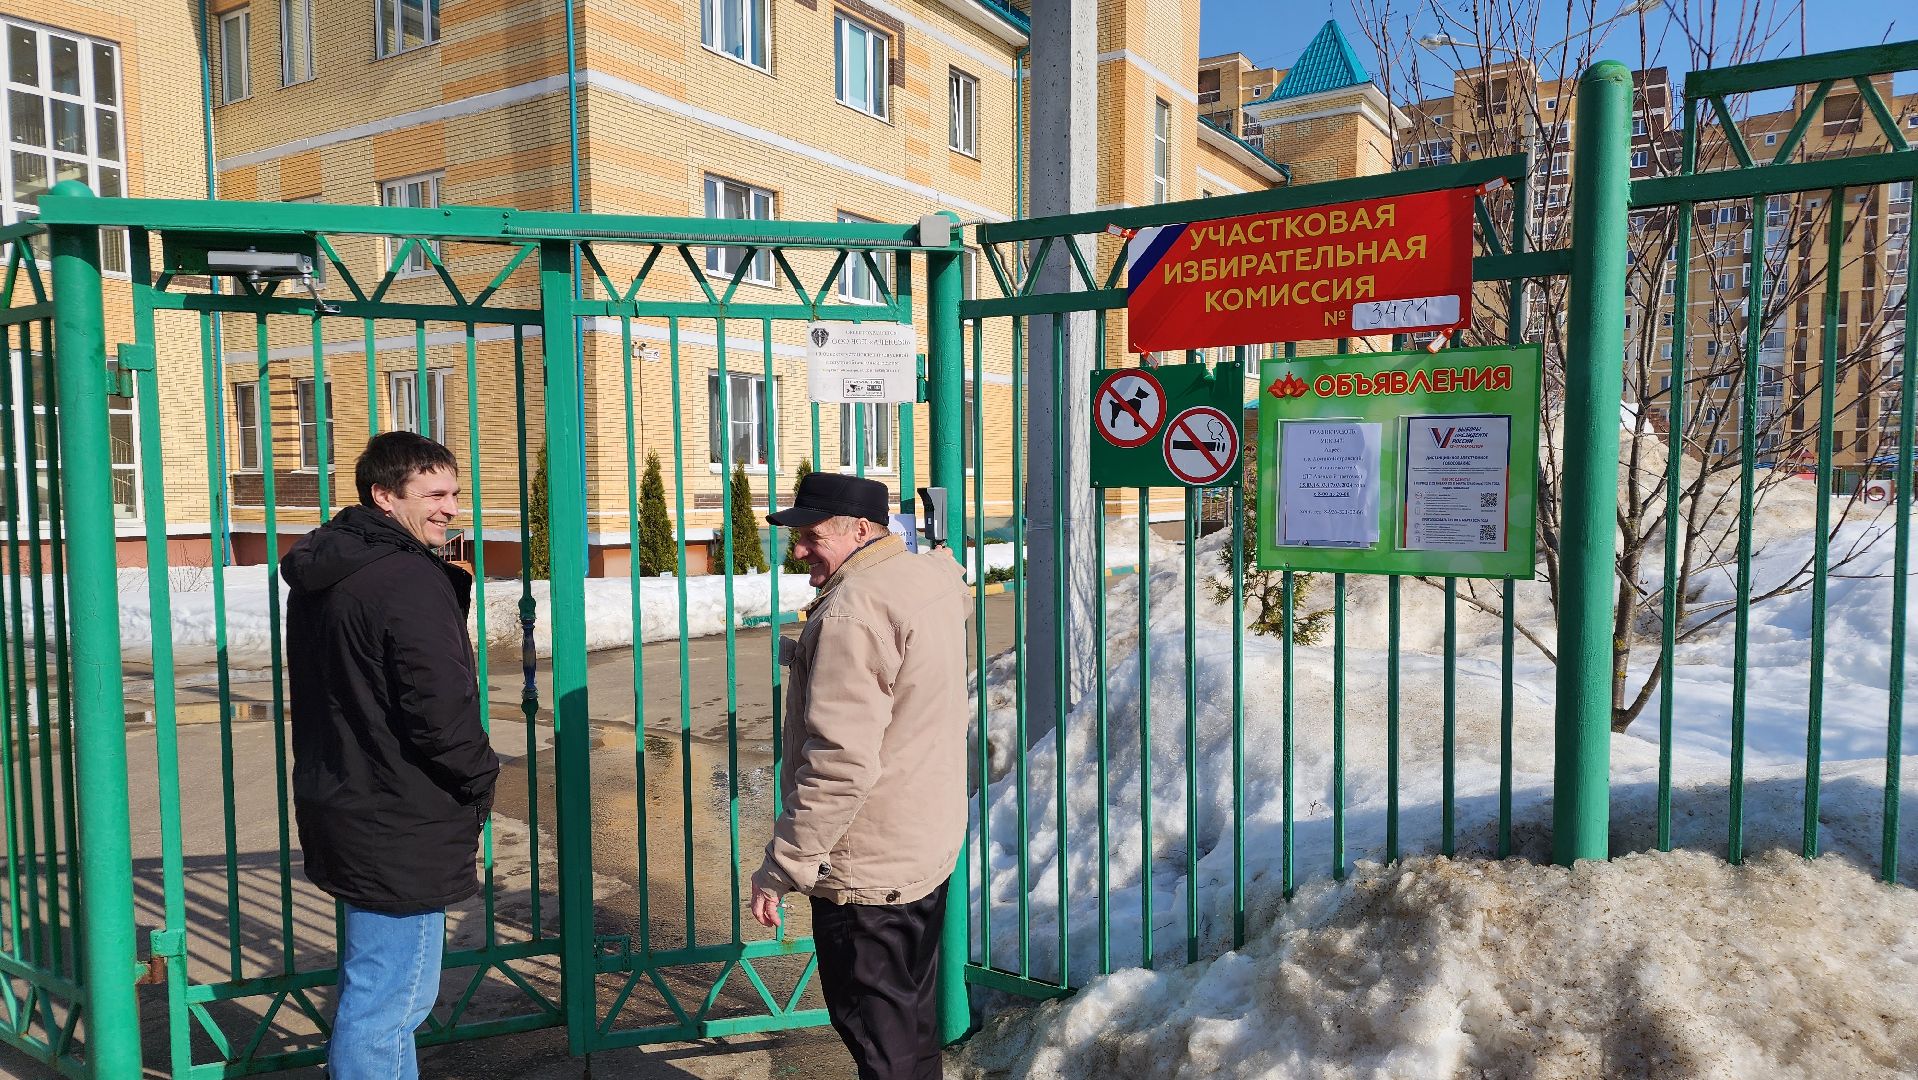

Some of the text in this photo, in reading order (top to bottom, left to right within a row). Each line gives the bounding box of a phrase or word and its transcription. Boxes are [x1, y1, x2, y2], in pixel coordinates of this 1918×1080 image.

[1190, 203, 1397, 250] УЧАСТКОВАЯ
[1164, 235, 1427, 285] ИЗБИРАТЕЛЬНАЯ
[1205, 274, 1375, 312] КОМИССИЯ
[1324, 310, 1346, 327] №
[1369, 298, 1429, 325] 3471
[1313, 364, 1513, 398] ОБЪЯВЛЕНИЯ
